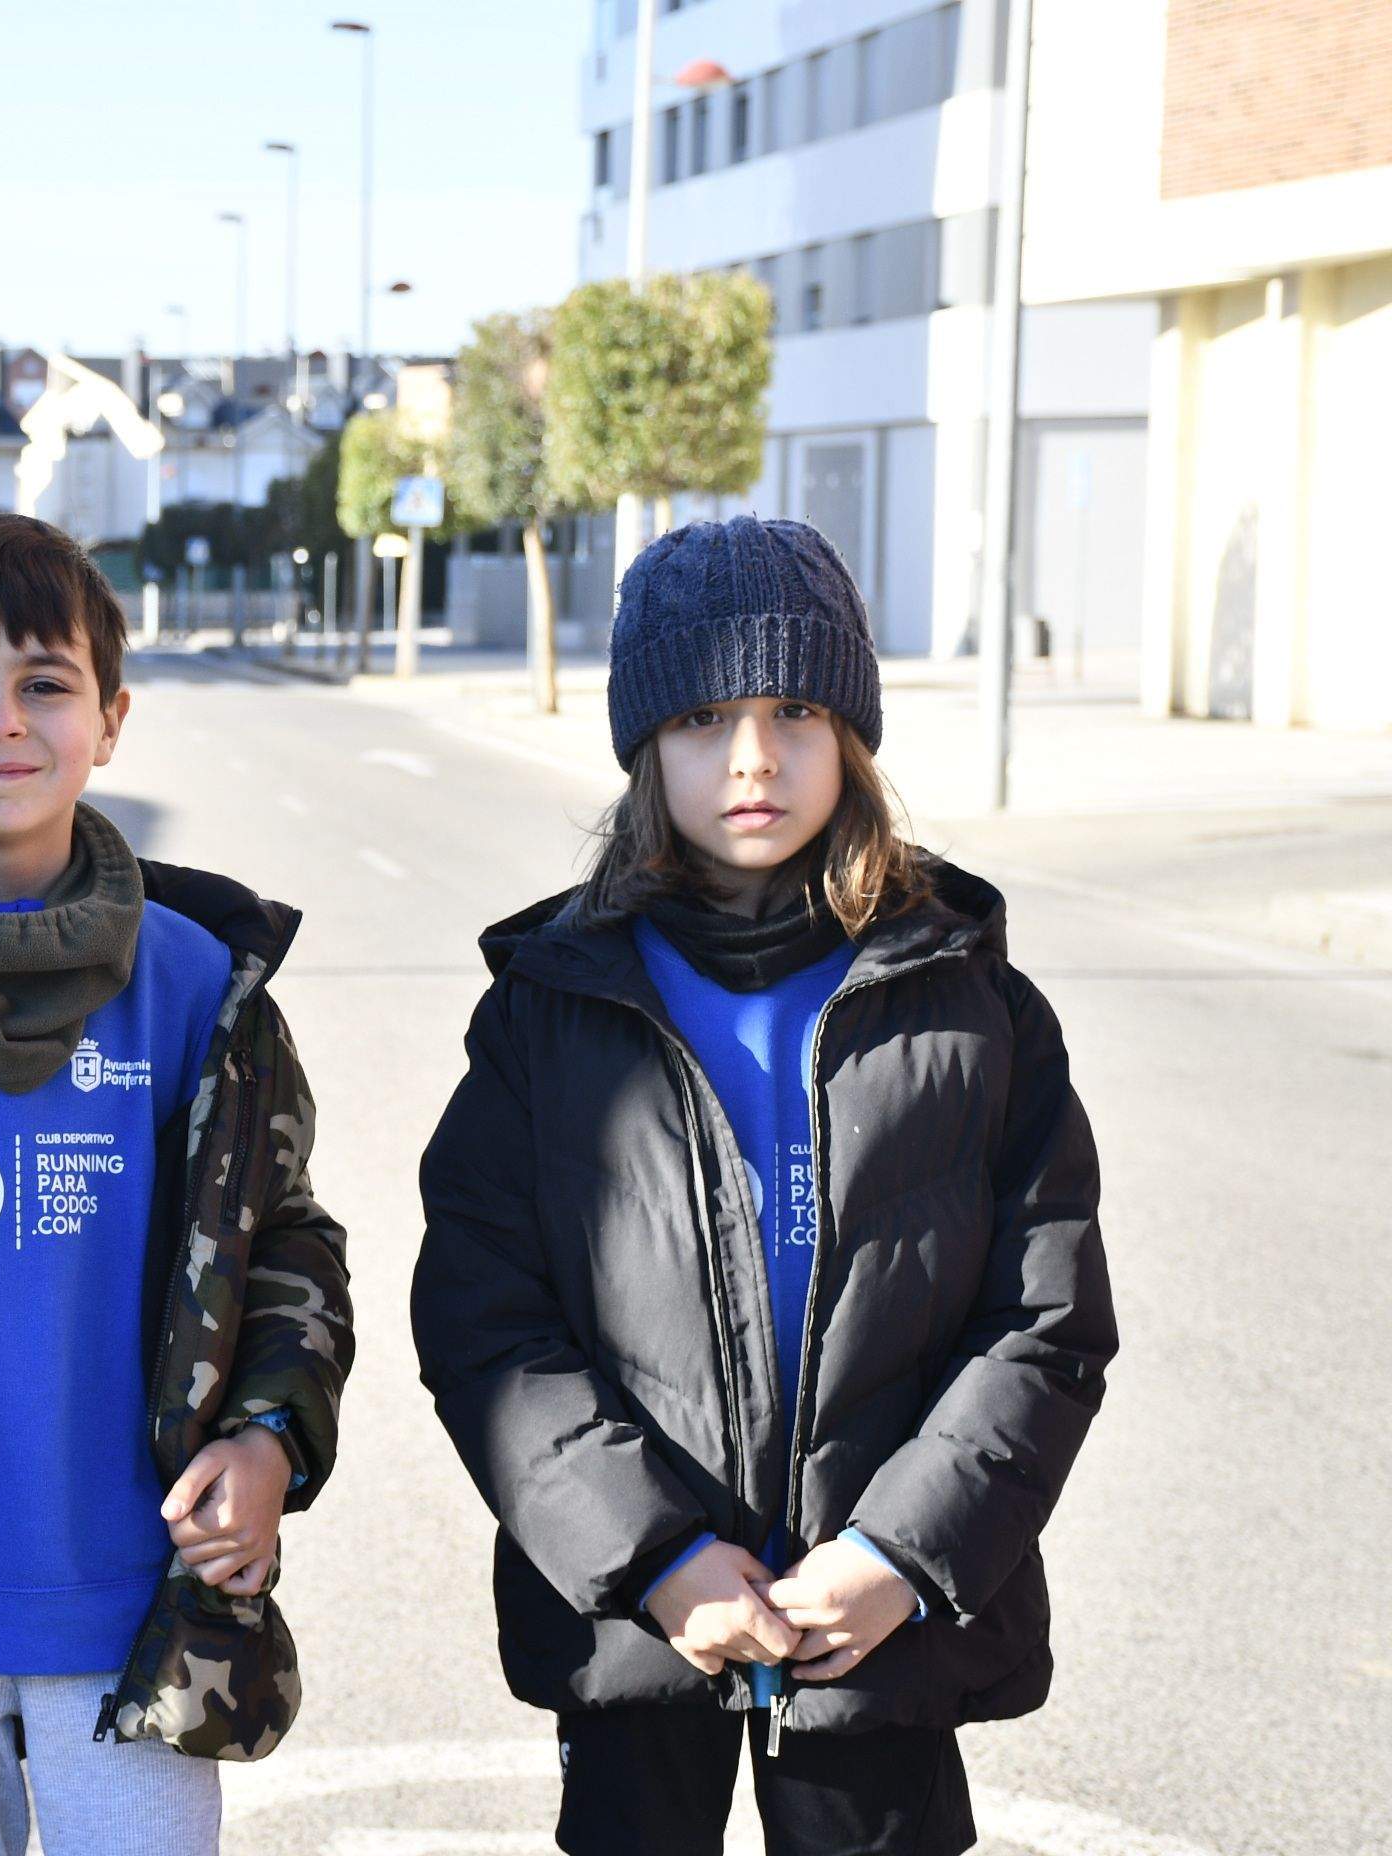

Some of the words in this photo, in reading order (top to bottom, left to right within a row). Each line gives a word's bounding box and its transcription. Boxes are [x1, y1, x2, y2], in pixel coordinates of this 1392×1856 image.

[35, 1133, 62, 1145] CLUB
[63, 1133, 115, 1145] DEPORTIVO
[37, 1153, 125, 1174] RUNNING
[37, 1174, 88, 1193] PARA
[38, 1195, 98, 1214] TODOS
[31, 1216, 82, 1235] .COM
